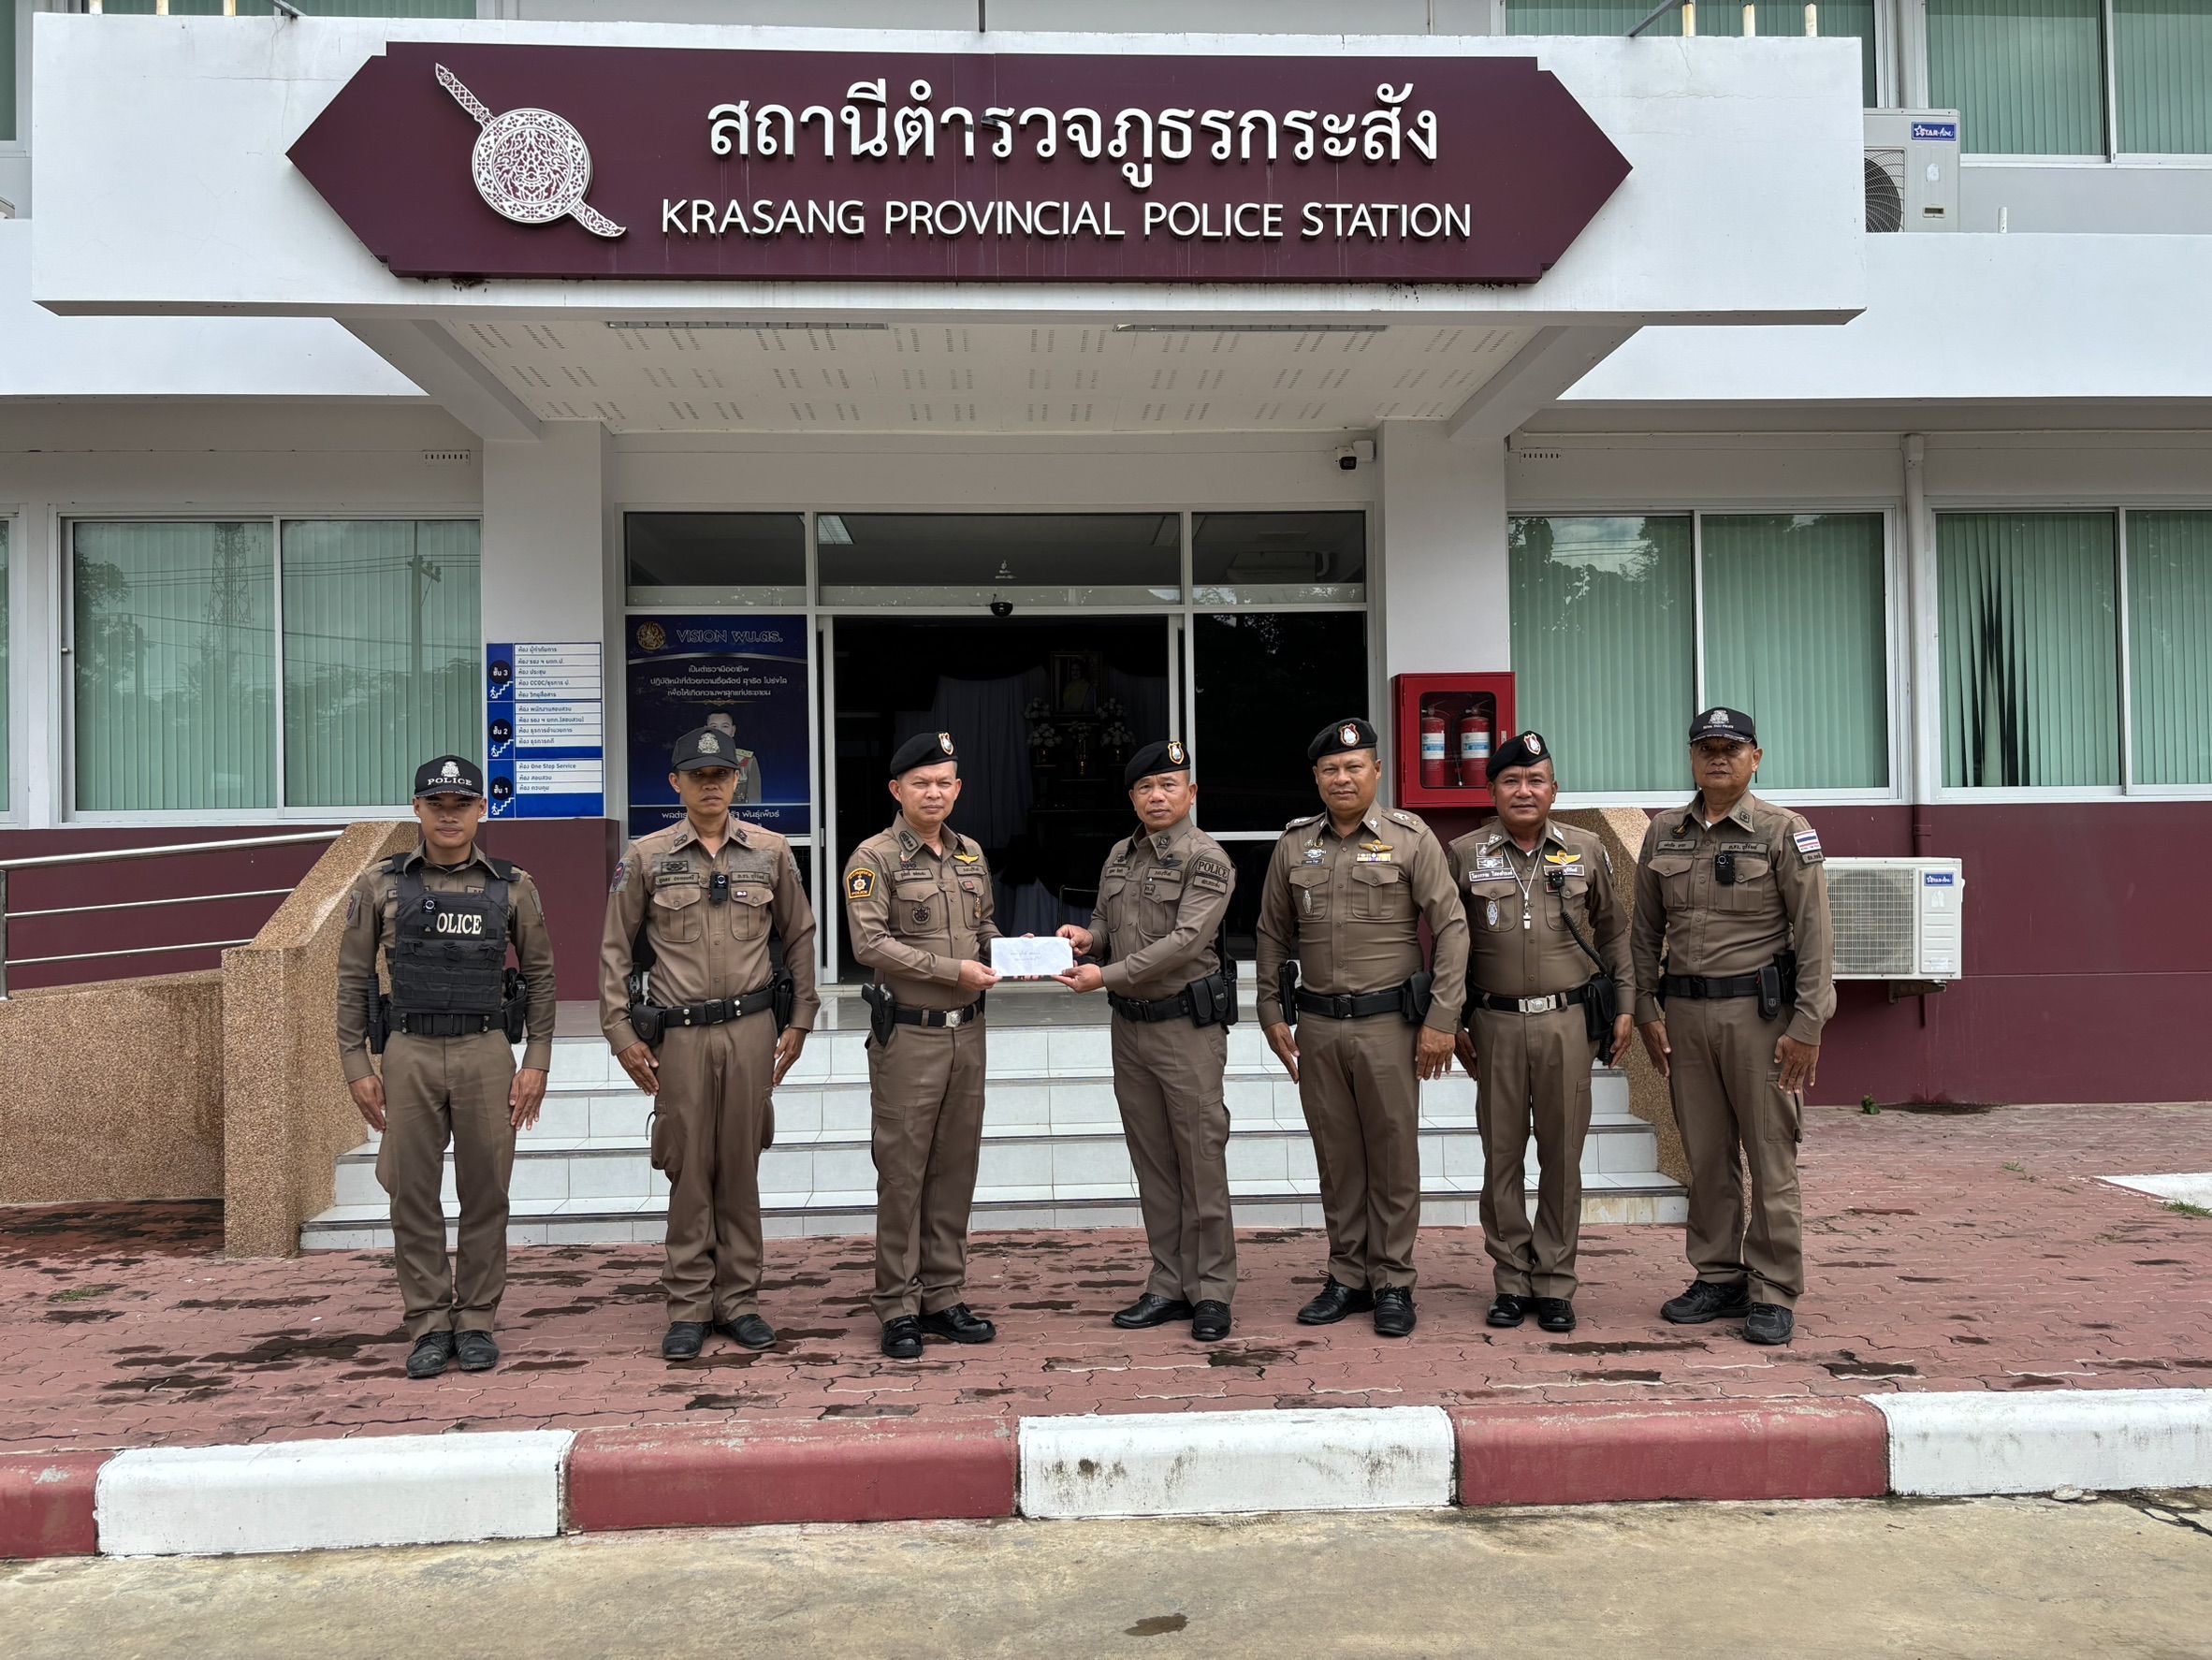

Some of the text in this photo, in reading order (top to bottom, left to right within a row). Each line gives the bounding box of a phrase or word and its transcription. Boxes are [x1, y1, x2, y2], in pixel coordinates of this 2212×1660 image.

[708, 79, 1437, 188] สถานีตำรวจภูธรกระสัง
[662, 199, 1471, 236] KRASANG PROVINCIAL POLICE STATION
[677, 629, 728, 644] VISION
[427, 777, 473, 786] POLICE
[662, 809, 688, 820] พลตำร
[1198, 861, 1229, 879] POLICE
[436, 912, 483, 935] OLICE
